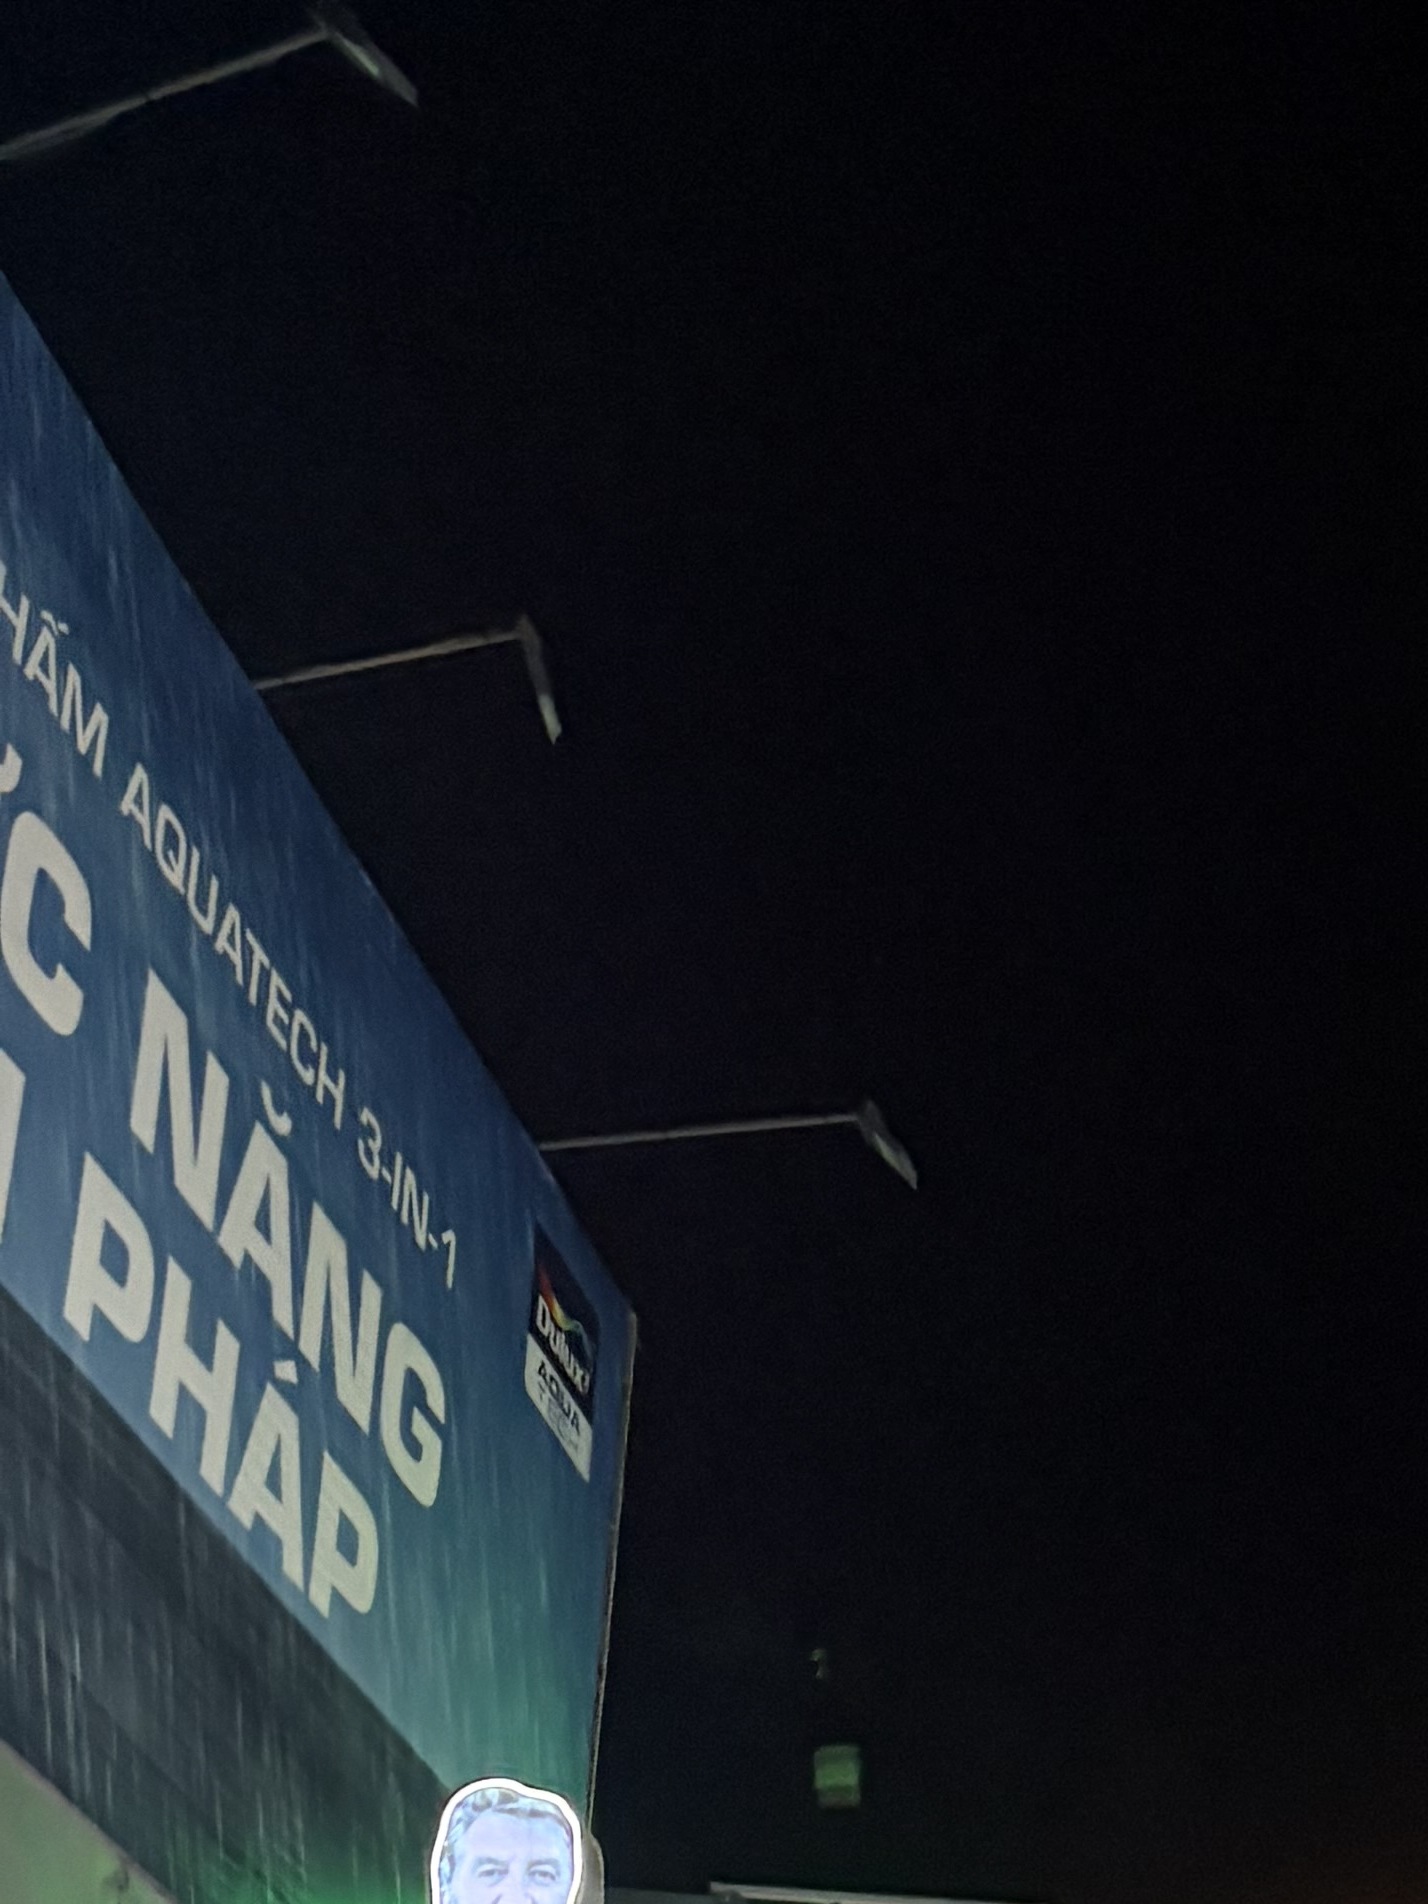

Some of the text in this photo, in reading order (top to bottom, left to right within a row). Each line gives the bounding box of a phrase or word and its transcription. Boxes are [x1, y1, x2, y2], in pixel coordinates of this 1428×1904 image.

[120, 762, 346, 1134] AQUATECH
[357, 1105, 460, 1290] 3-IN-1
[130, 966, 448, 1508] NĂNG
[62, 1152, 380, 1621] PHÁP
